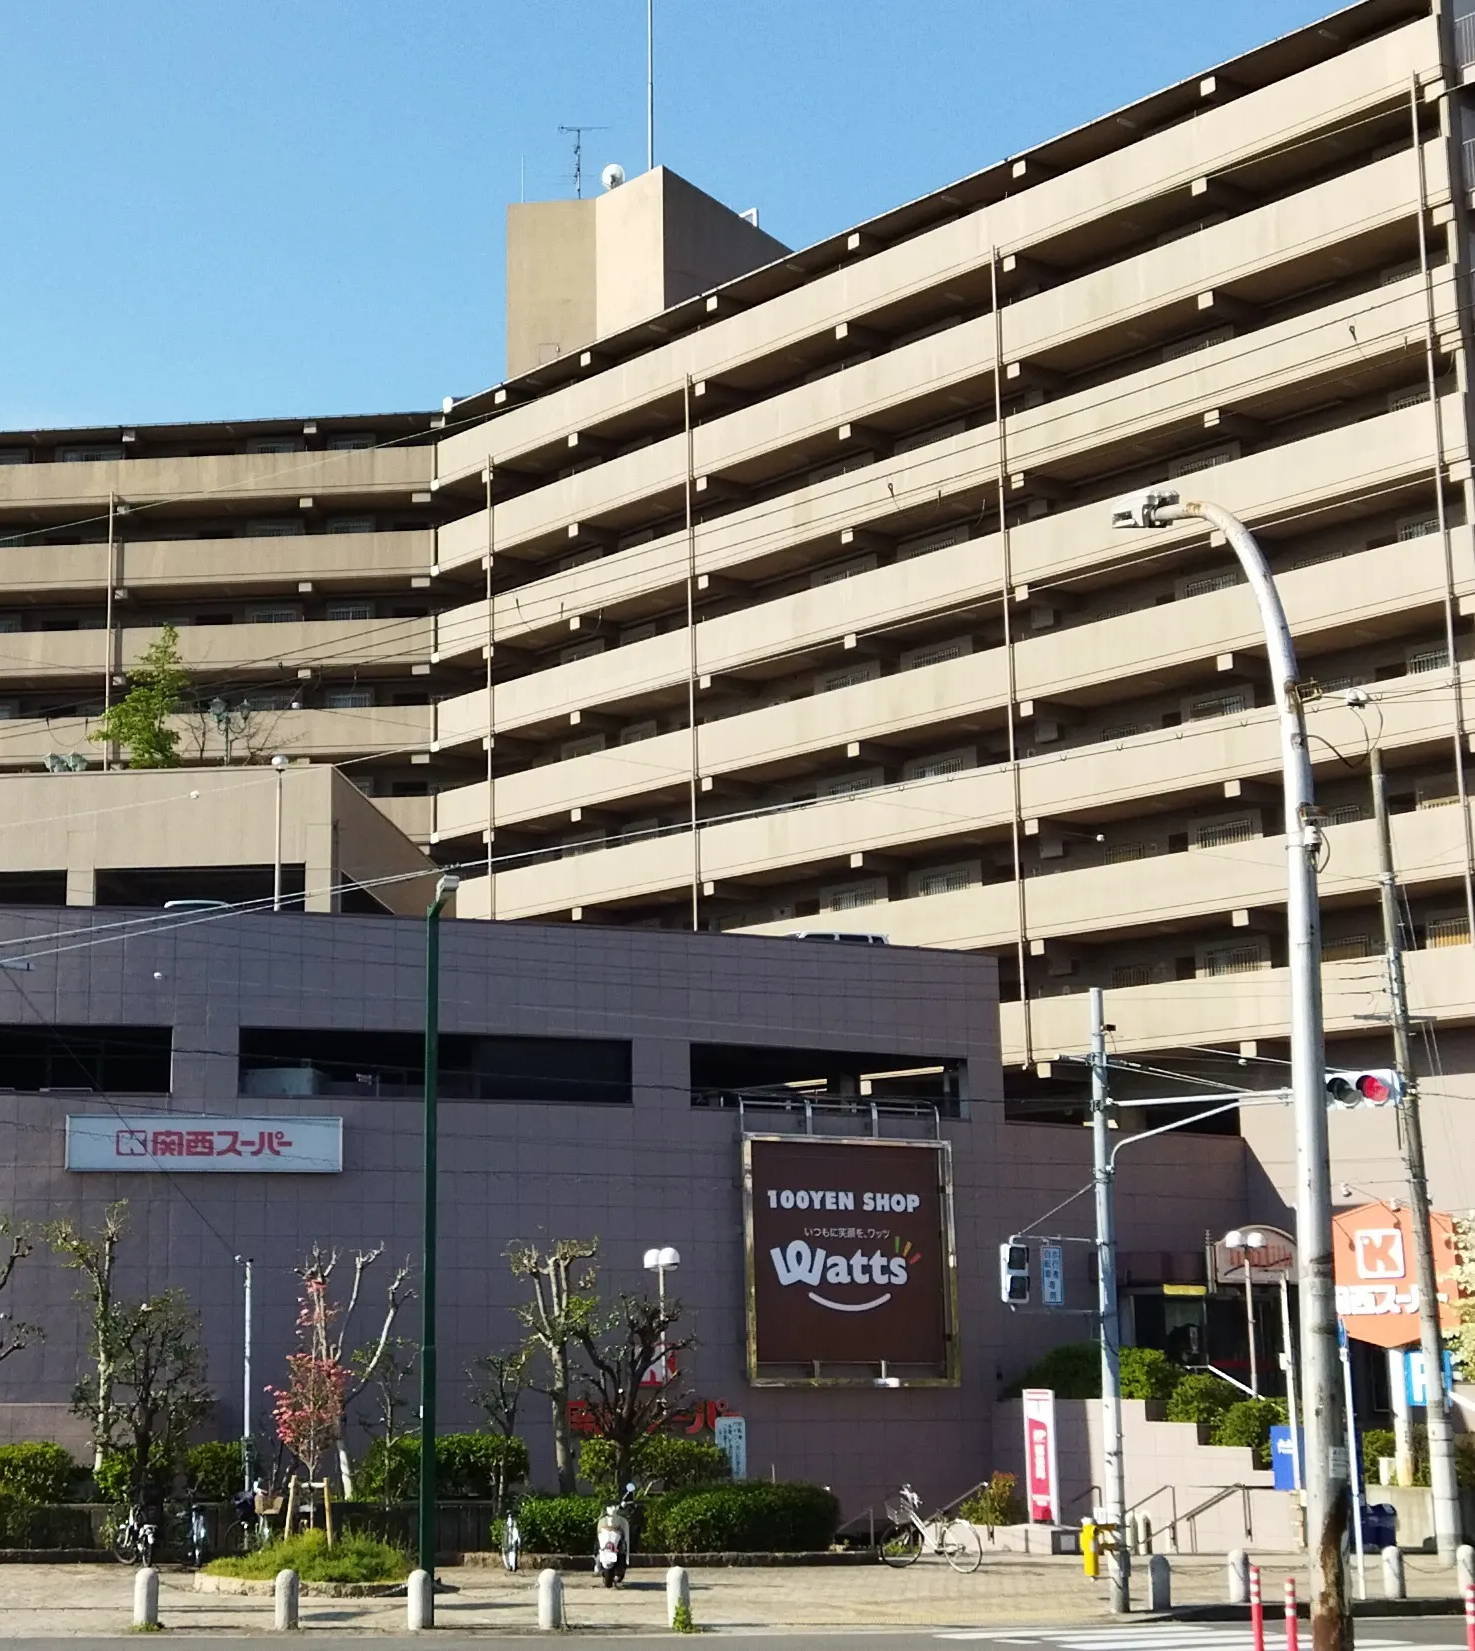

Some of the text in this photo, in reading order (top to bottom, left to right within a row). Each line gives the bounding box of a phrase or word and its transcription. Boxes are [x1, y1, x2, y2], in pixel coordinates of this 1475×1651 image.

[152, 1130, 293, 1156] 関西スーパー
[767, 1189, 920, 1213] 100YEN SHOP
[769, 1239, 908, 1287] Watts
